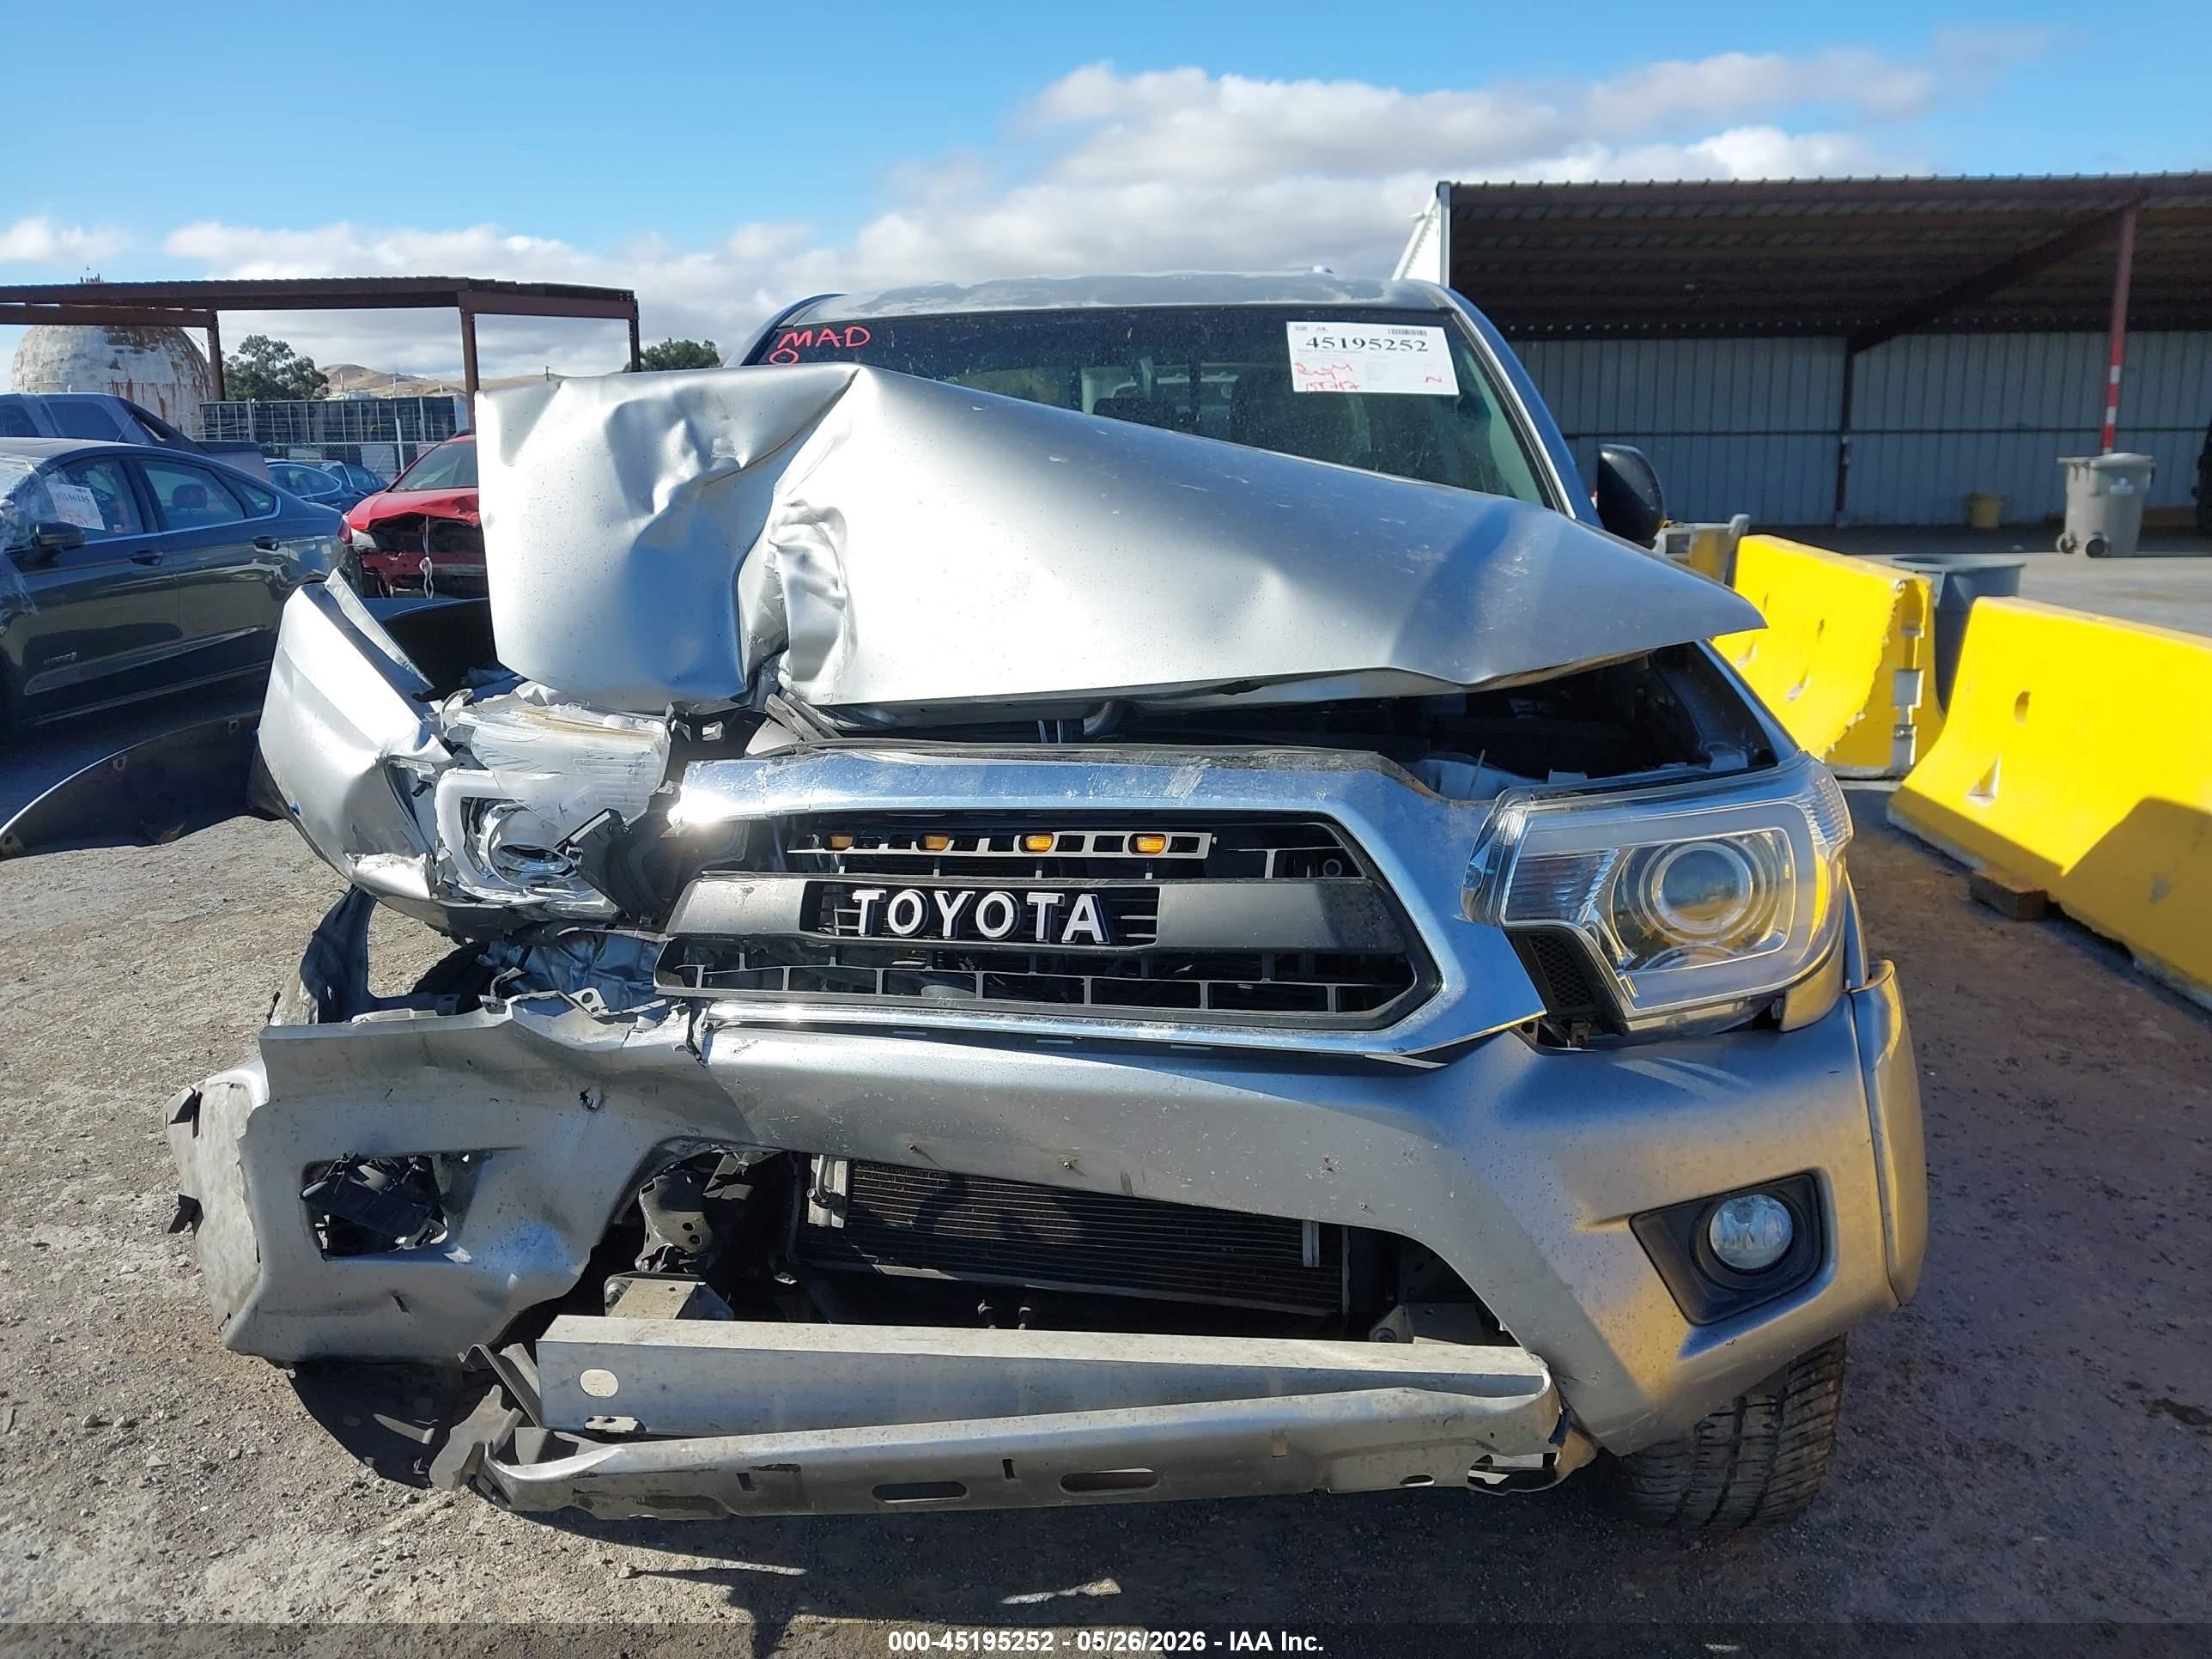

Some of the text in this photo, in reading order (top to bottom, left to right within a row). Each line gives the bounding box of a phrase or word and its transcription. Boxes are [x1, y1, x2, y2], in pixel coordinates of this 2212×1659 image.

[777, 325, 872, 349] MAD
[1305, 337, 1428, 352] 45195252
[852, 888, 1111, 944] TOYOTA
